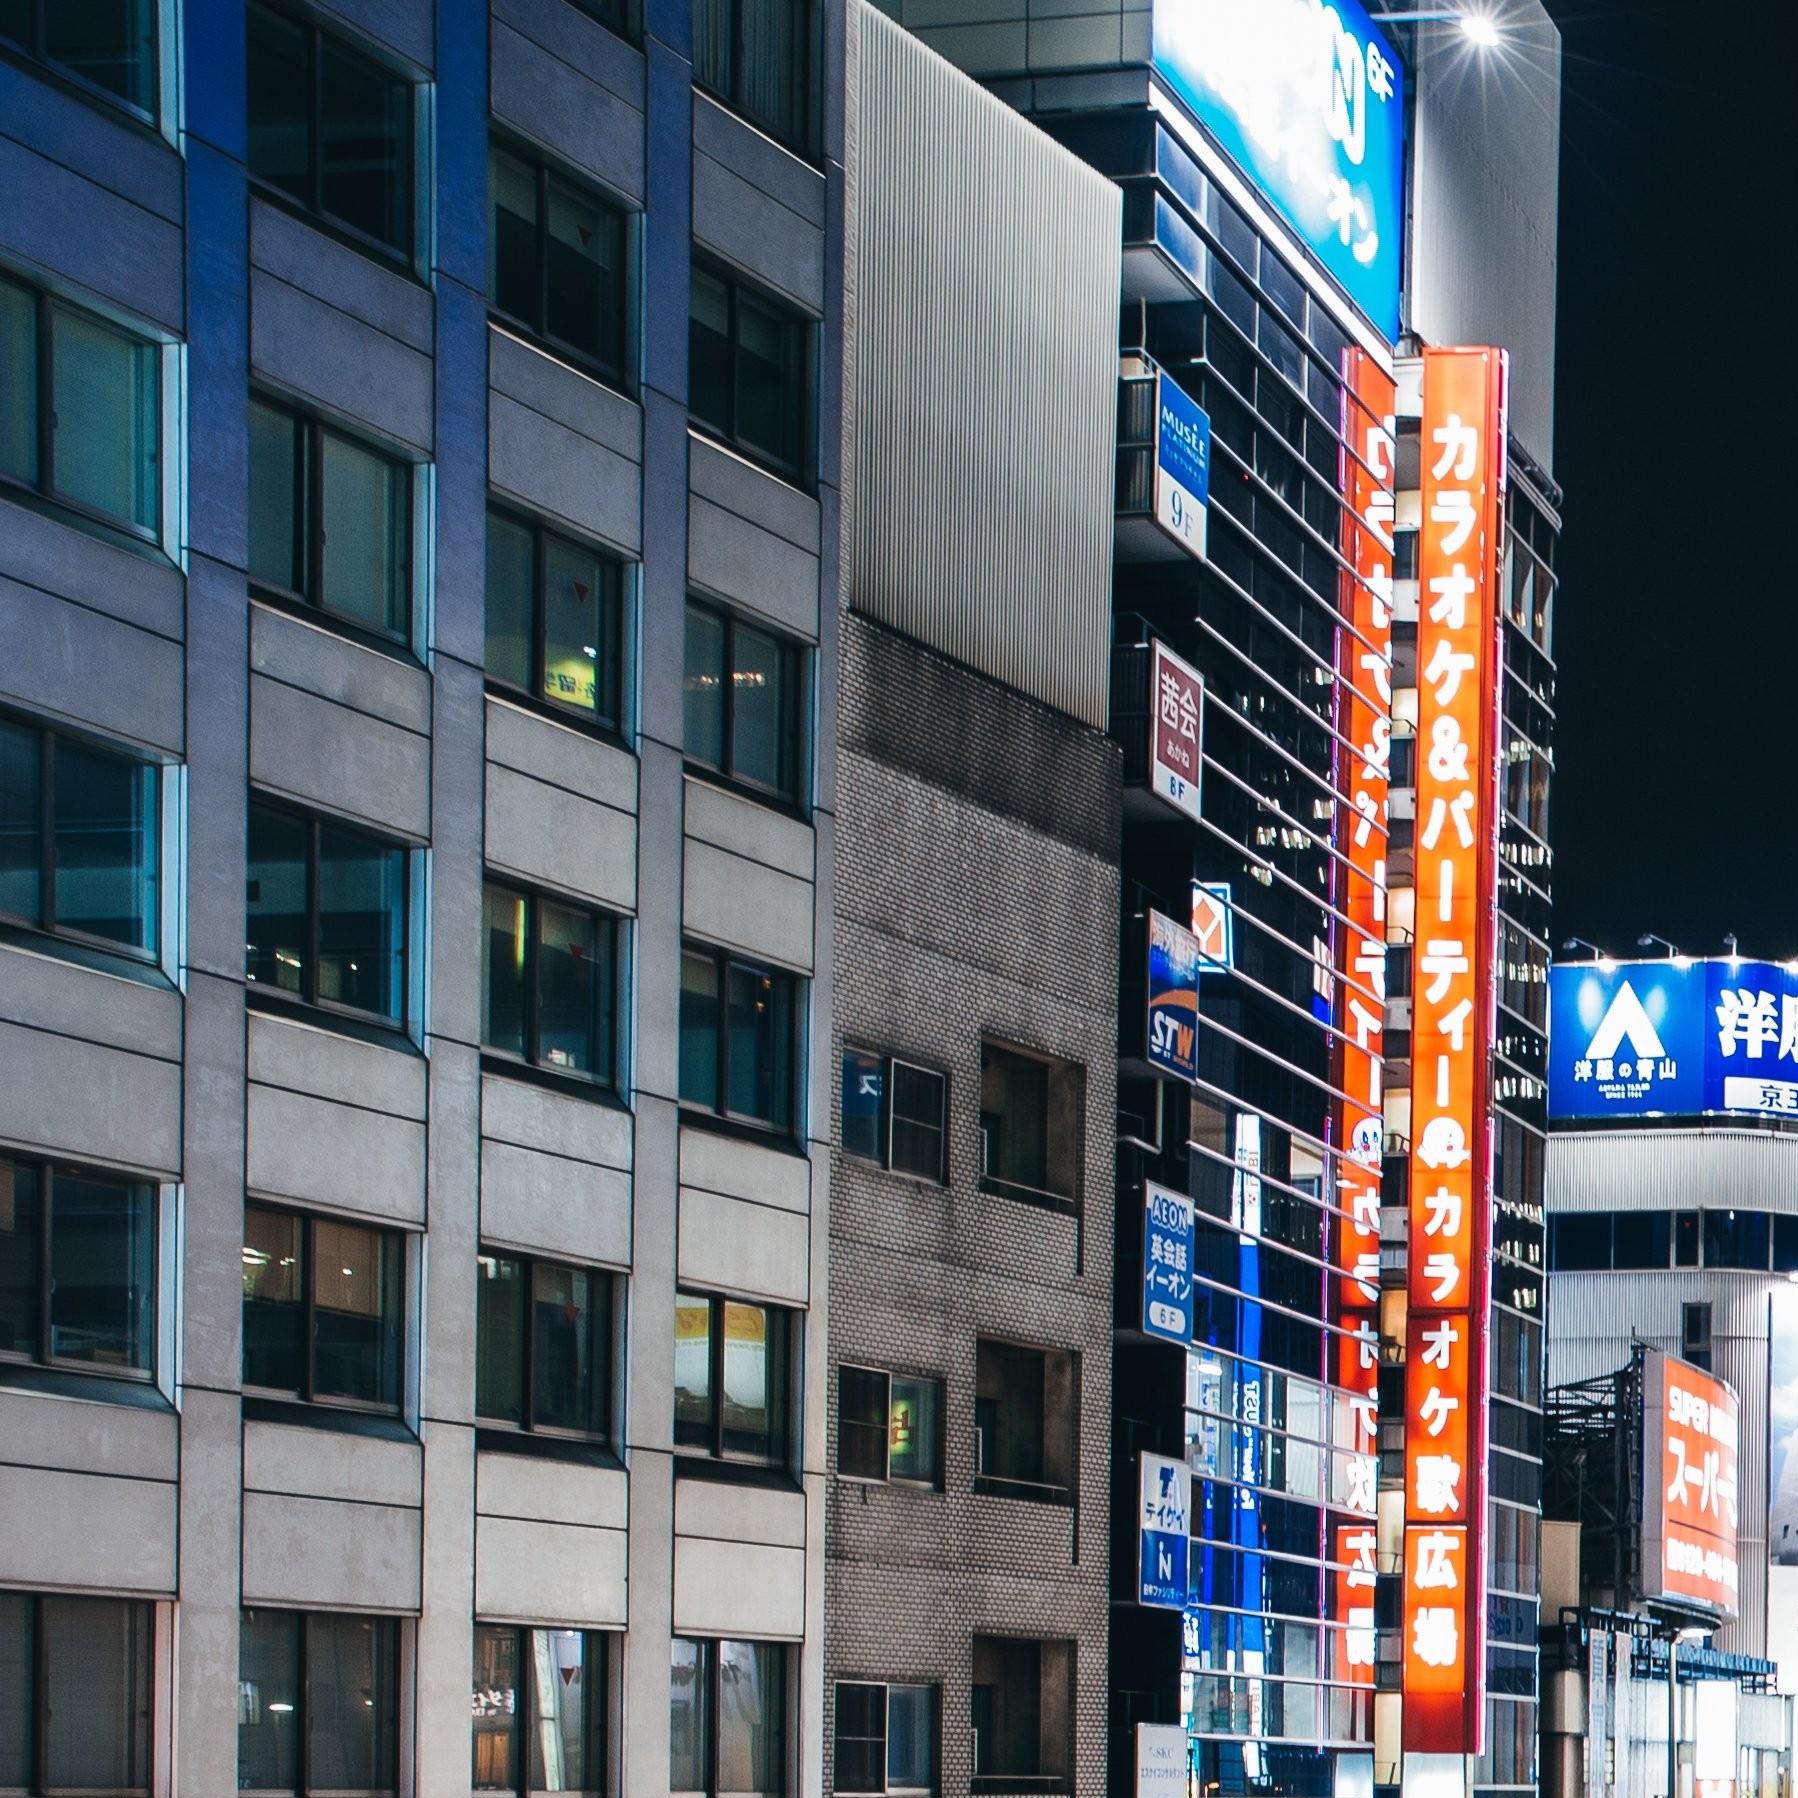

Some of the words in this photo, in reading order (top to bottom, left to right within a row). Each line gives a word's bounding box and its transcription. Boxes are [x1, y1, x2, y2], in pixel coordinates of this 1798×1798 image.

[1162, 406, 1205, 458] MUSÉE
[1171, 491, 1194, 538] 9F
[1161, 672, 1198, 744] 茜会
[1167, 739, 1190, 769] あかね
[1420, 415, 1478, 1107] カラオケ&パーティー
[1169, 776, 1185, 800] 8F
[1574, 1058, 1677, 1082] 洋服の青山
[1151, 1195, 1189, 1236] AEON
[1151, 1233, 1188, 1272] 英会話
[1146, 1264, 1191, 1301] イーオン
[1159, 1308, 1176, 1327] 6F
[1413, 1187, 1461, 1667] カラオケ歌広場
